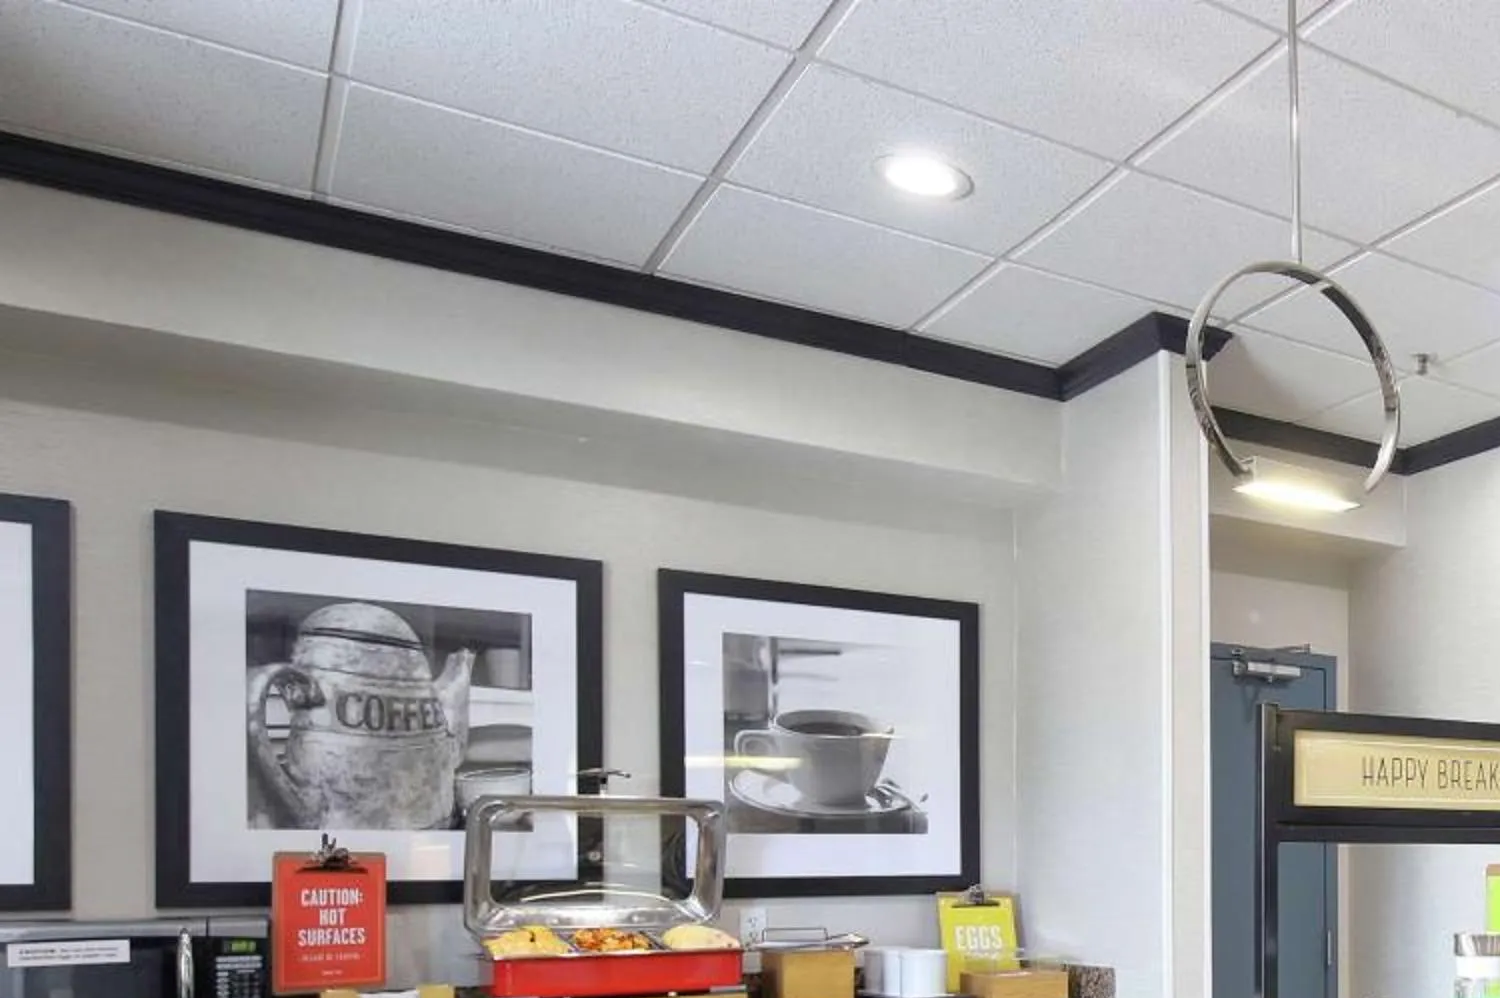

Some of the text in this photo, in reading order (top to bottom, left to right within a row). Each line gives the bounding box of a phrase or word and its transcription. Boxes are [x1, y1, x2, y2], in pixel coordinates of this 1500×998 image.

[1362, 756, 1429, 788] HAPPY
[301, 887, 364, 907] CAUTION:
[319, 907, 347, 926] HOT
[298, 927, 366, 947] SURFACES
[955, 925, 1003, 949] EGGS
